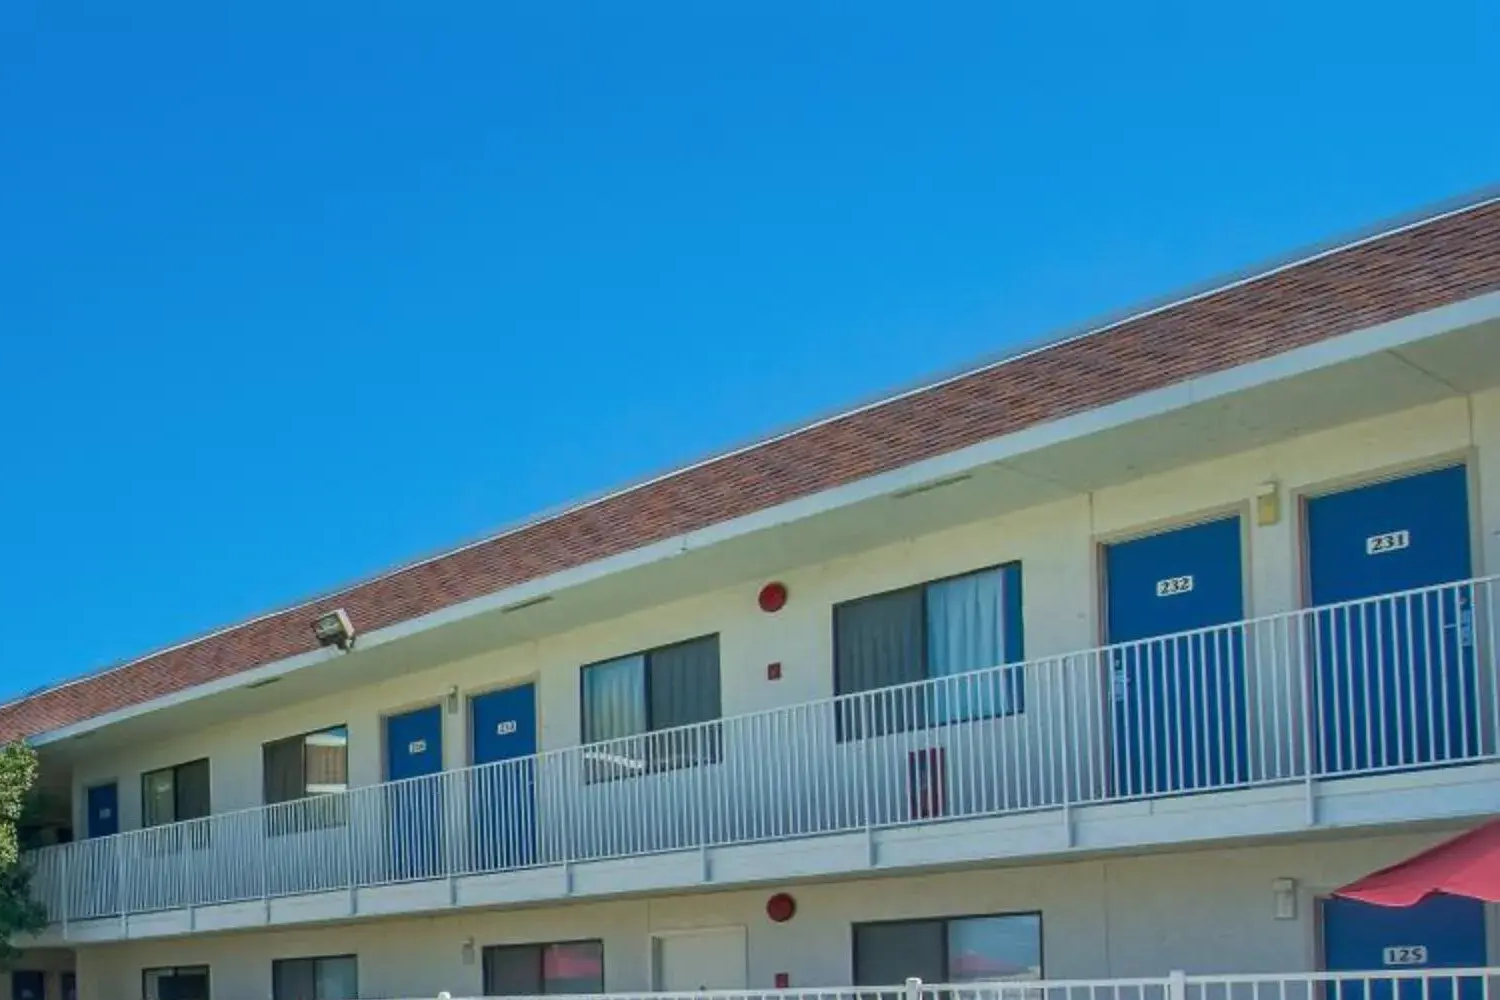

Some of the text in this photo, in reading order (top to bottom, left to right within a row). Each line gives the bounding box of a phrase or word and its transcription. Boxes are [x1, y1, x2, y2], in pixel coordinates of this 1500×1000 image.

[1371, 533, 1404, 551] 231
[1161, 577, 1189, 594] 232
[1389, 947, 1424, 962] 125
